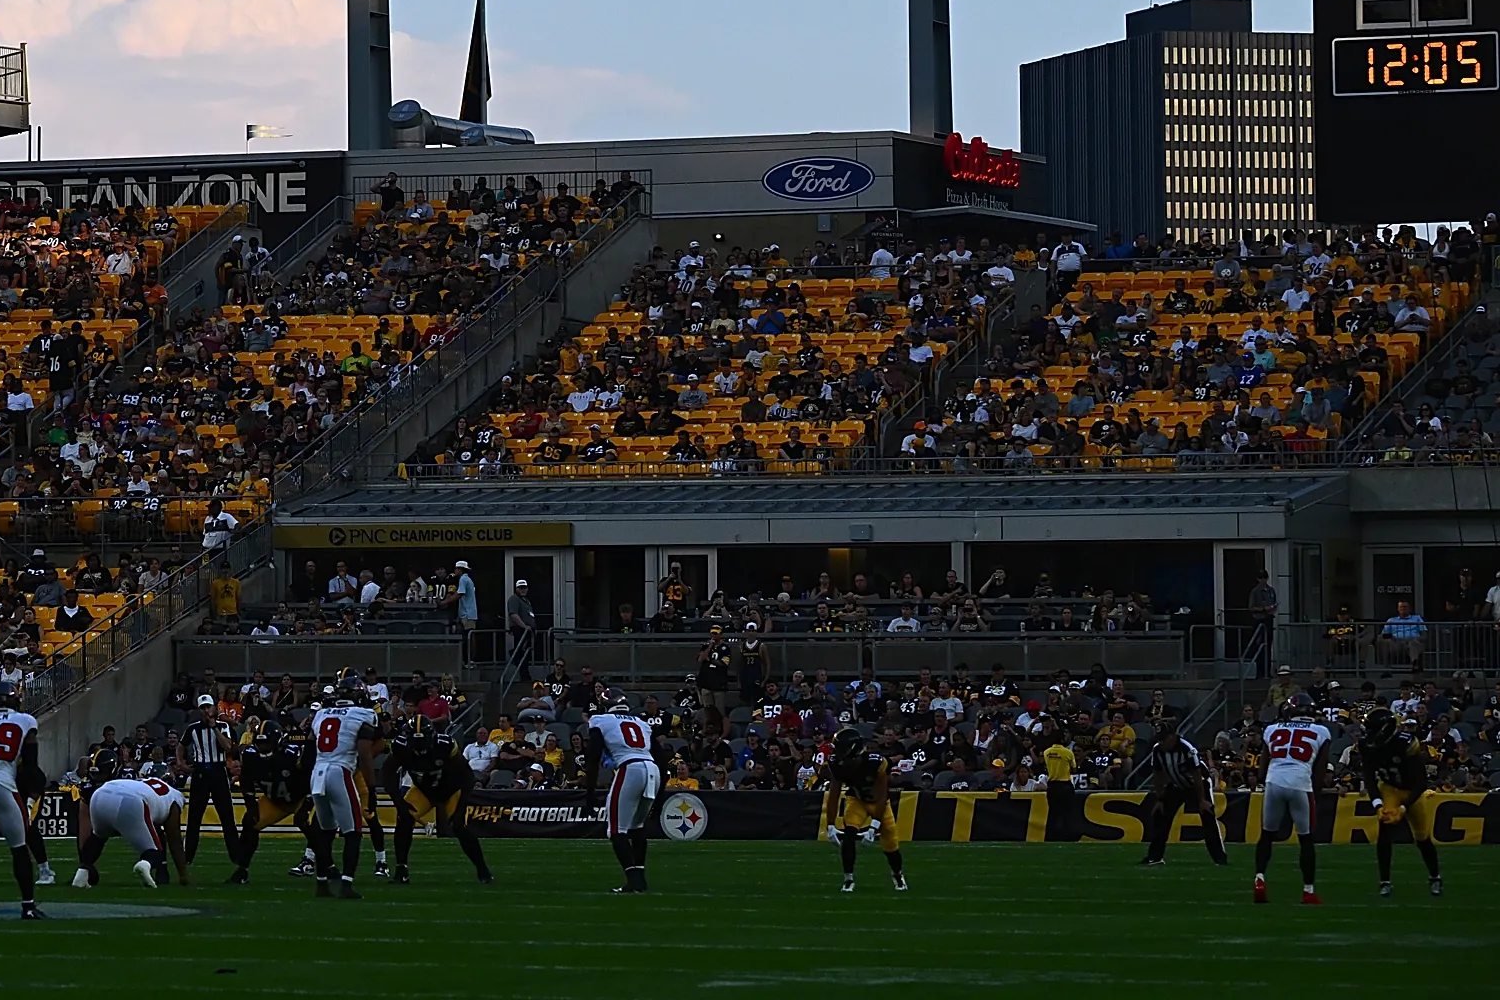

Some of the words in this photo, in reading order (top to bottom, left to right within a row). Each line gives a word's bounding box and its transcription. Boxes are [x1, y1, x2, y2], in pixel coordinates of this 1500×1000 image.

[1367, 41, 1481, 87] 12:05
[785, 164, 852, 194] Ford
[62, 176, 157, 212] FAN
[172, 172, 307, 213] ZONE
[946, 187, 963, 204] Pizza
[964, 191, 970, 206] &
[972, 192, 989, 209] Draft
[990, 195, 1009, 212] House
[47, 235, 60, 248] 90
[1200, 301, 1214, 315] 90
[1344, 320, 1358, 333] 56
[1134, 333, 1147, 346] 55
[122, 395, 140, 406] 58
[1195, 387, 1208, 400] 39
[774, 407, 787, 418] 90
[477, 430, 490, 444] 33
[349, 529, 386, 544] PNC
[390, 530, 472, 542] CHAMPIONS
[476, 529, 513, 541] CLUB
[433, 584, 446, 600] 10
[665, 585, 682, 599] 43
[551, 683, 563, 695] 90
[763, 705, 781, 719] 59
[1323, 708, 1339, 722] 32
[318, 717, 342, 753] 8
[620, 721, 645, 749] 0
[1269, 728, 1318, 762] 25
[261, 780, 292, 802] 74
[41, 797, 68, 817] ST.
[509, 806, 610, 823] FOOTBALL.CO
[38, 819, 68, 836] 933
